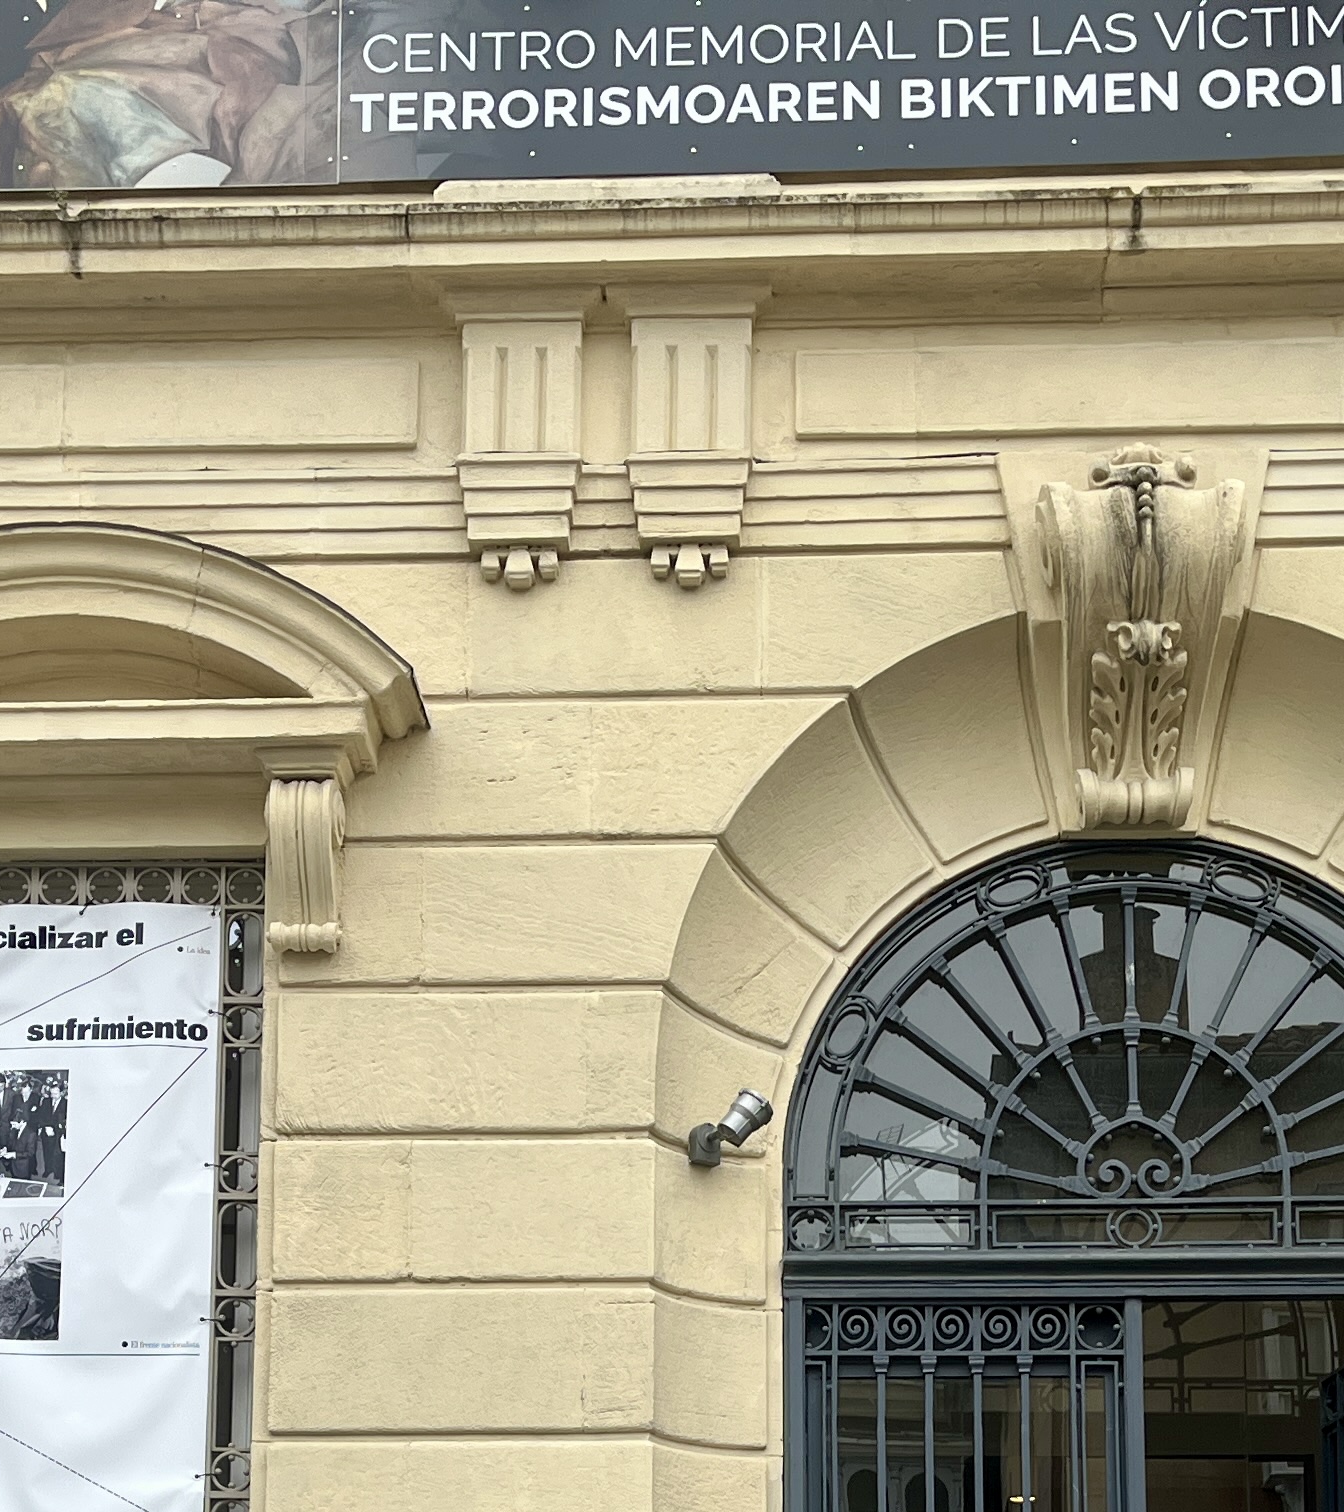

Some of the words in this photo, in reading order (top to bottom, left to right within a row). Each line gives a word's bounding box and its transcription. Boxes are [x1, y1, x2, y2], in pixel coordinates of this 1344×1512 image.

[362, 29, 595, 73] CENTRO
[614, 20, 916, 68] MEMORIAL
[938, 17, 1010, 59] DE
[1032, 12, 1138, 56] LAS
[348, 80, 880, 133] TERRORISMOAREN
[900, 71, 1178, 119] BIKTIMEN
[116, 922, 144, 947] el
[26, 1015, 209, 1042] sufrimiento
